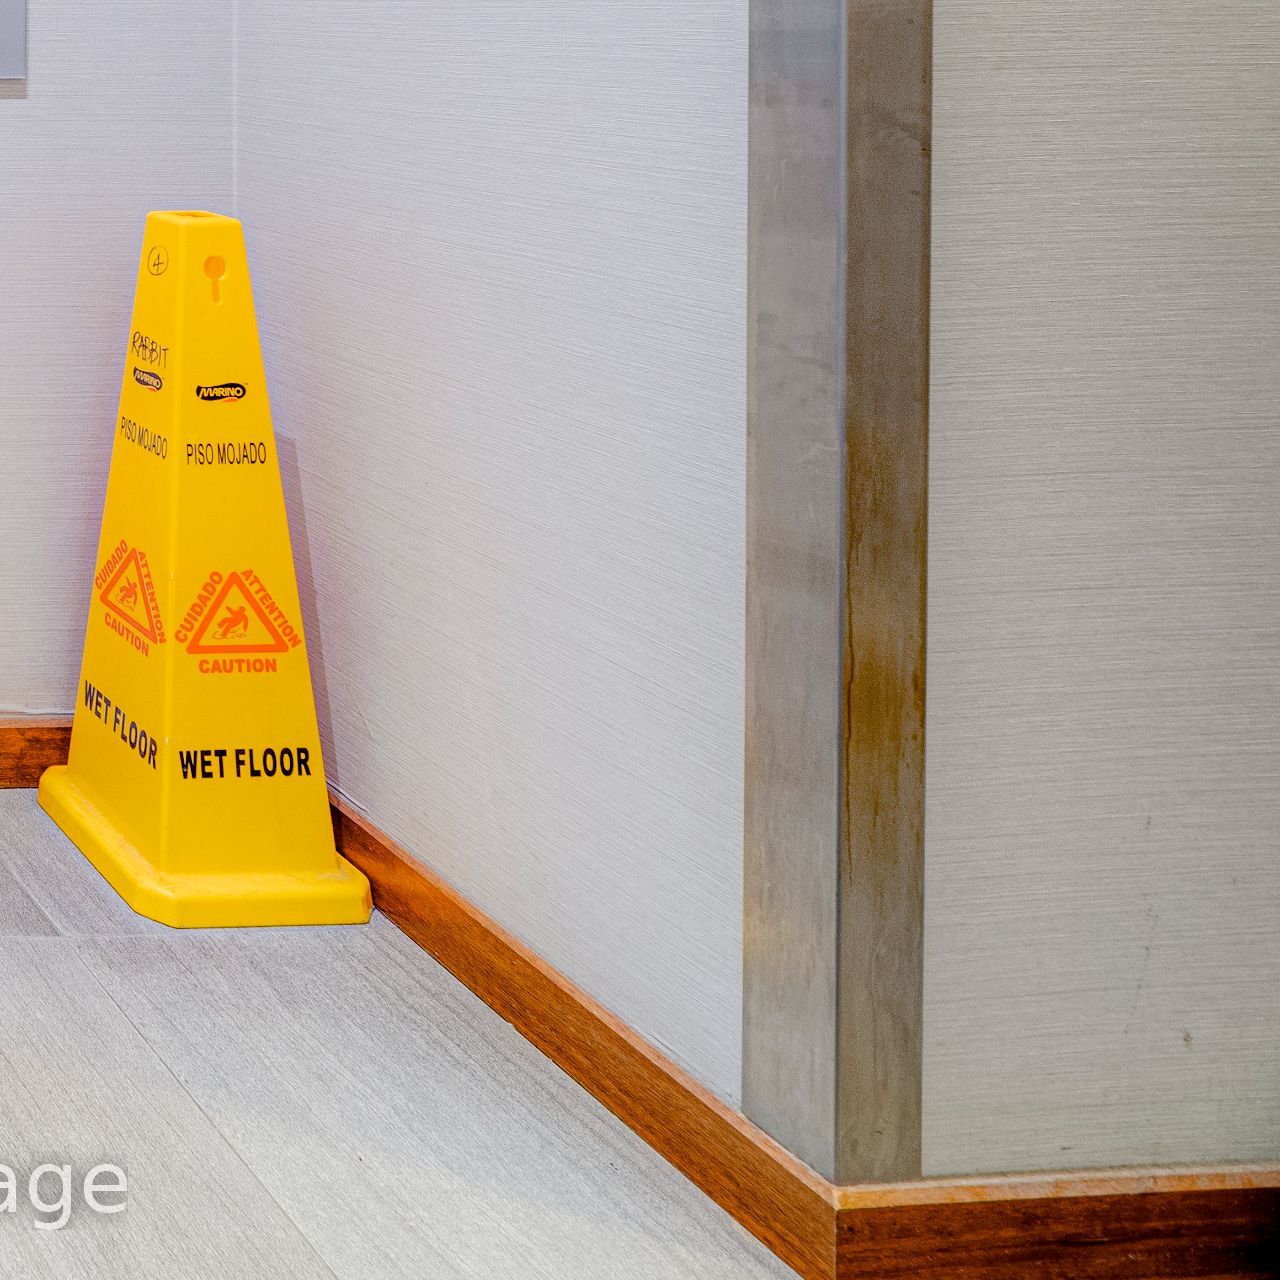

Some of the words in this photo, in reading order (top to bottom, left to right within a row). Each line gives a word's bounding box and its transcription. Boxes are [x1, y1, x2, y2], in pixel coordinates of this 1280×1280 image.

[134, 368, 162, 389] MARINO
[198, 385, 243, 398] MARINO
[121, 416, 137, 443] PISO
[138, 425, 168, 460] MOJADO
[186, 443, 214, 465] PISO
[217, 442, 267, 465] MOJADO
[95, 539, 129, 591] CUIDADO
[138, 551, 167, 645] ATTENTION
[174, 571, 224, 644] CUIDADO
[241, 569, 303, 649] ATTENTION
[104, 611, 149, 657] CAUTION
[198, 658, 278, 674] CAUTION
[84, 679, 112, 725] WET
[113, 705, 158, 770] FLOOR
[179, 749, 227, 780] WET
[235, 747, 312, 778] FLOOR
